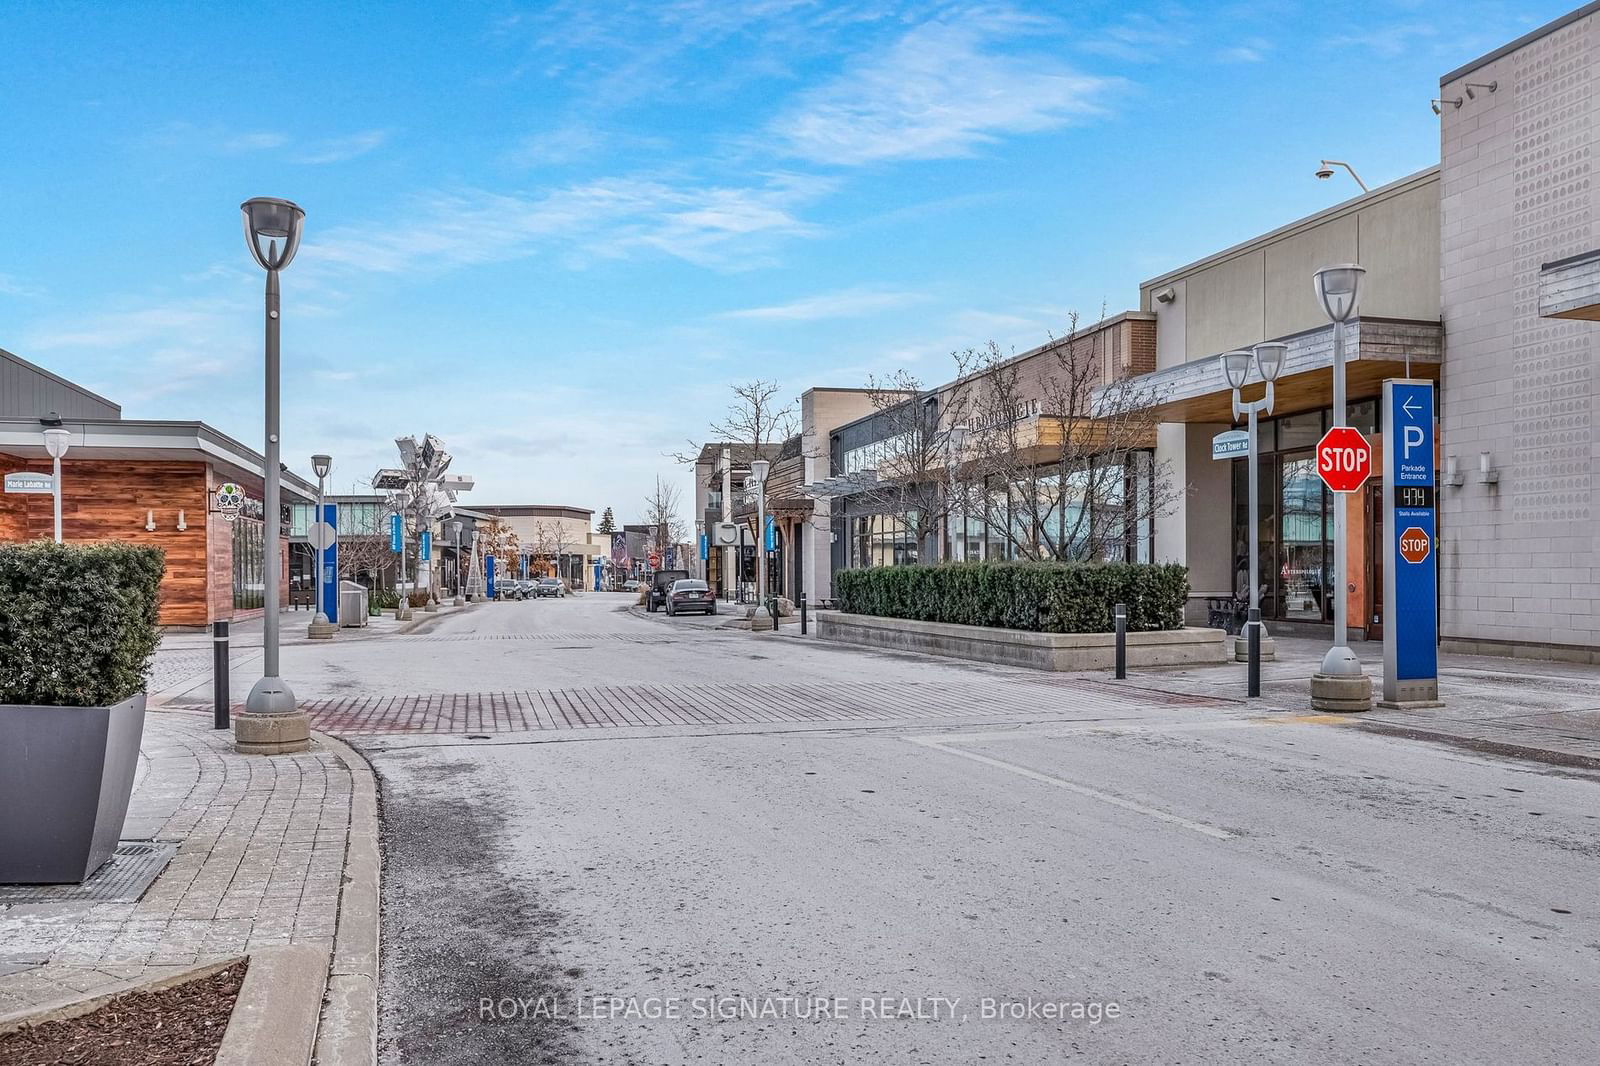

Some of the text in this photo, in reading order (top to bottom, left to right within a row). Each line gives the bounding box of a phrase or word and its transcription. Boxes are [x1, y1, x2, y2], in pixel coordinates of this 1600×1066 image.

[1214, 442, 1228, 453] Clock
[1227, 441, 1242, 451] Tower
[1403, 425, 1425, 460] P
[1321, 447, 1368, 472] STOP
[1401, 464, 1426, 472] Parkade
[1400, 472, 1427, 480] Entrance
[1402, 539, 1428, 552] STOP
